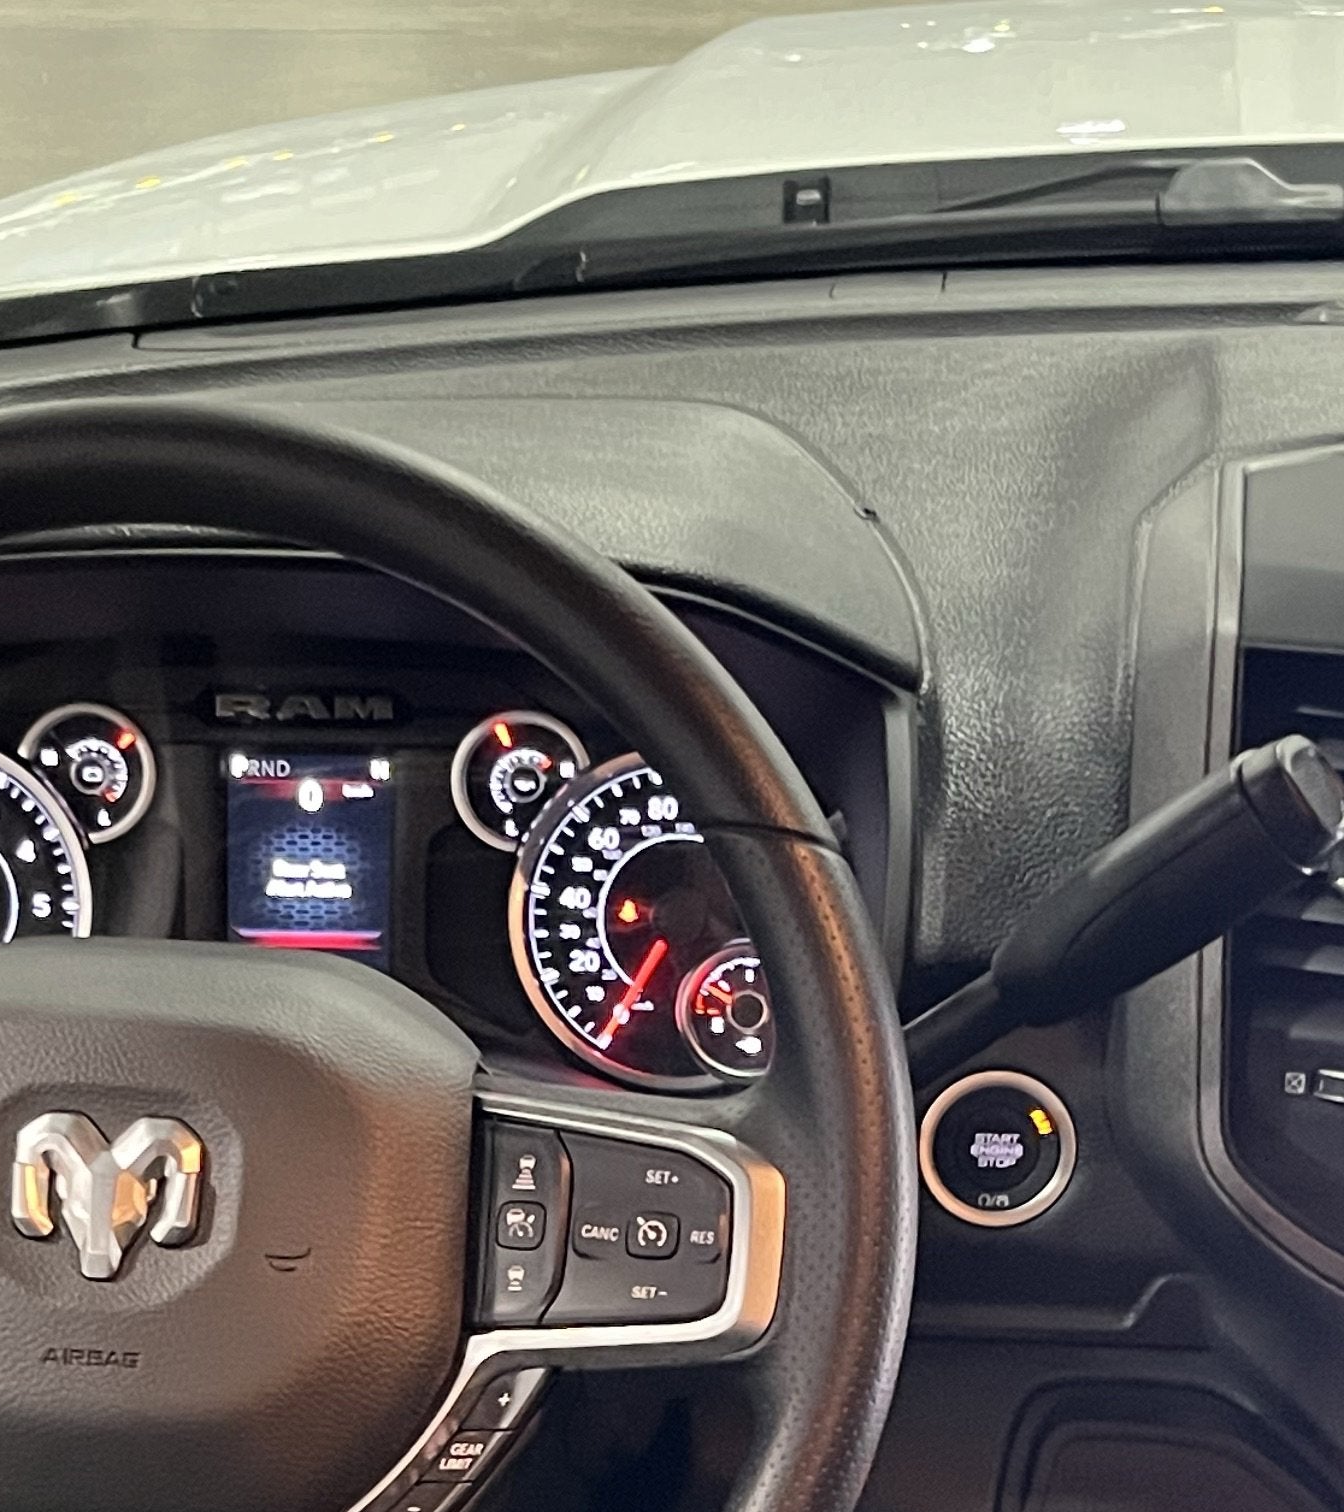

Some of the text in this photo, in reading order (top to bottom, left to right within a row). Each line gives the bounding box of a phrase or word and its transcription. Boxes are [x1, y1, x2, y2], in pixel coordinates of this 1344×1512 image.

[216, 695, 394, 721] RAM
[297, 778, 323, 812] 0
[648, 796, 679, 820] 80
[588, 827, 620, 850] 60
[16, 838, 36, 863] 4
[31, 892, 51, 918] 5
[559, 886, 591, 909] 40
[569, 949, 601, 973] 20
[974, 1132, 1021, 1145] START
[977, 1156, 1017, 1169] STOP
[581, 1223, 619, 1242] CANC
[689, 1229, 715, 1246] RES
[40, 1347, 141, 1369] AIRBAG
[450, 1442, 485, 1457] GEAR
[439, 1457, 474, 1471] LIMIT
